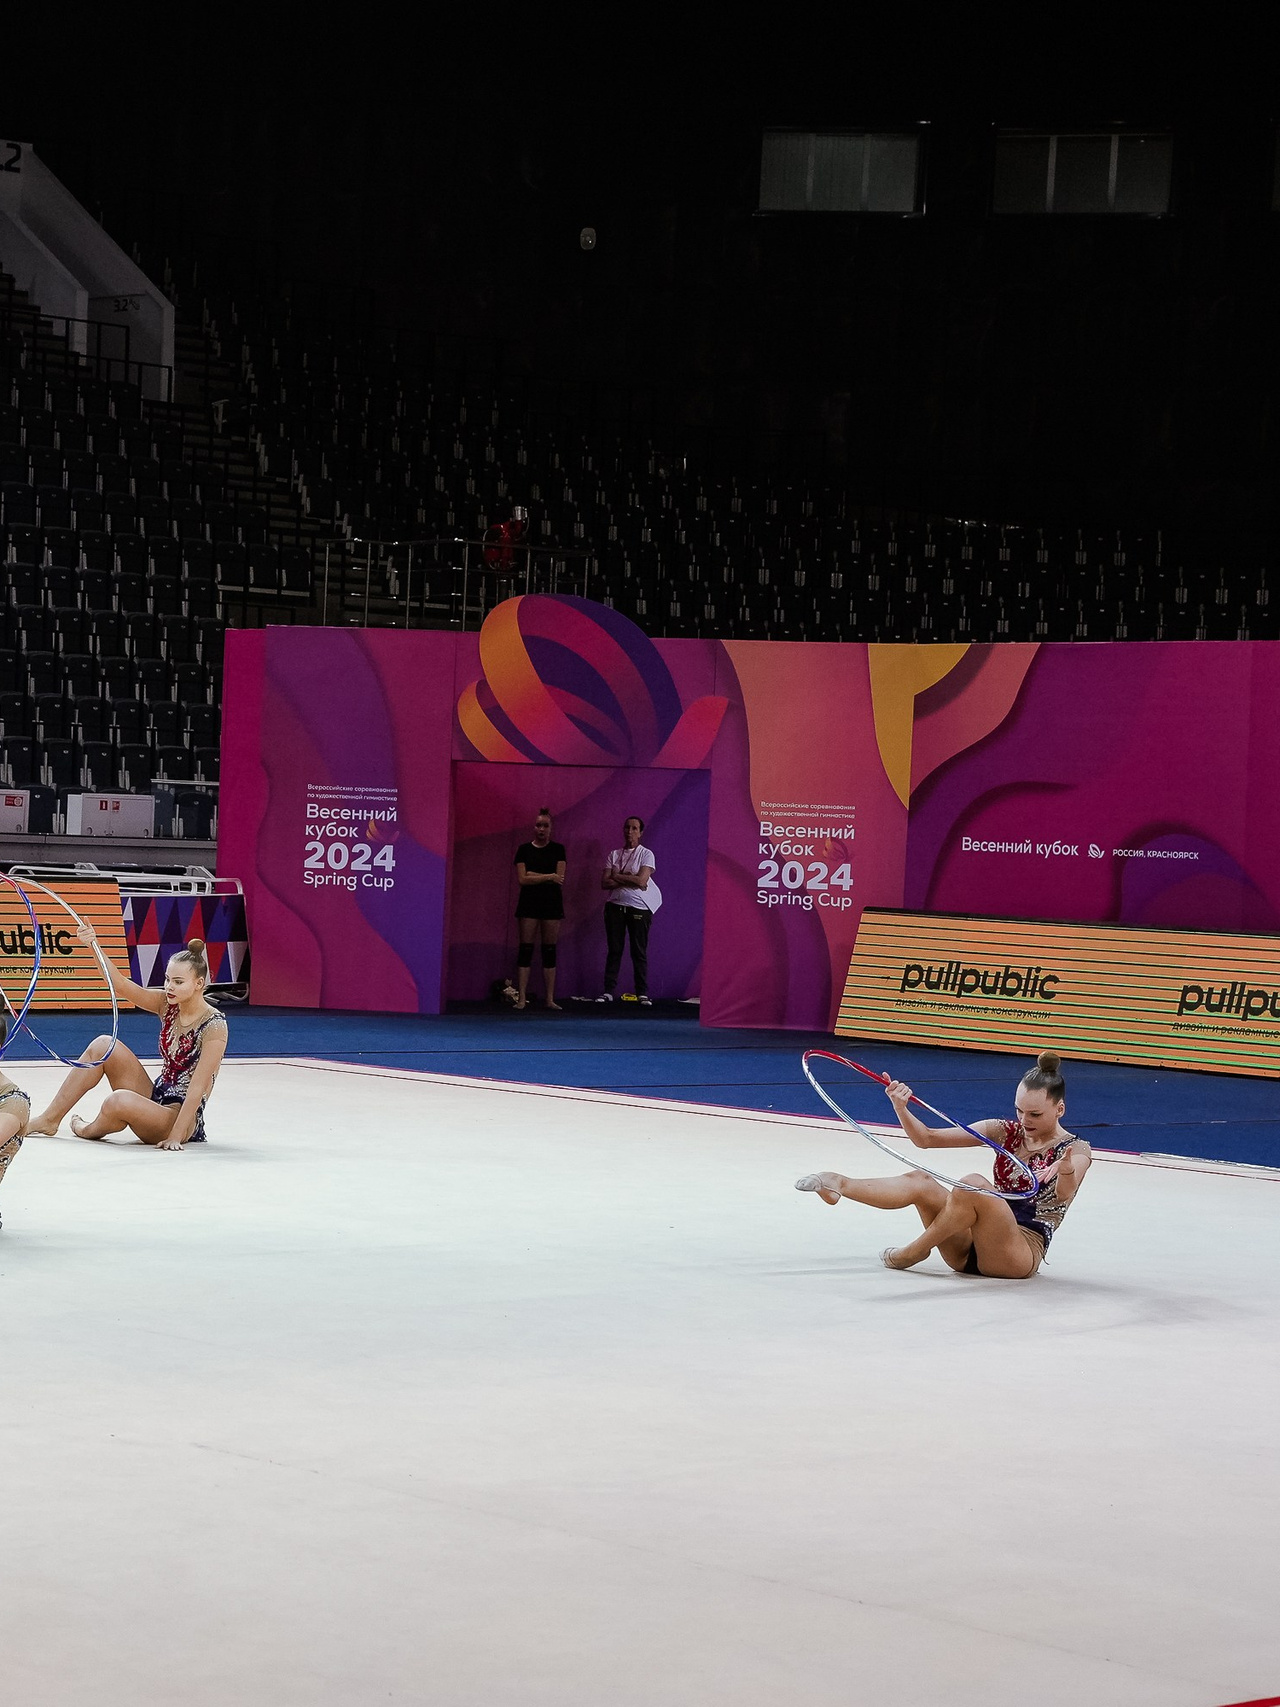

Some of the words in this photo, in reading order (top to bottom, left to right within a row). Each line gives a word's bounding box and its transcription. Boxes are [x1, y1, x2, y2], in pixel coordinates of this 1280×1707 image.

[307, 784, 354, 792] Всероссийские
[306, 803, 397, 822] Весенний
[761, 801, 809, 809] Всероссийские
[305, 822, 358, 840] кубок
[760, 821, 855, 840] Весенний
[304, 841, 396, 872] 2024
[758, 840, 814, 859] кубок
[962, 836, 1032, 854] Весенний
[1036, 840, 1079, 858] кубок
[1112, 849, 1146, 859] РОССИЯ,
[1147, 850, 1199, 860] КРАСНОЯРСК
[303, 871, 358, 891] Spring
[362, 874, 394, 892] Cup
[757, 860, 854, 891] 2024
[756, 890, 813, 910] Spring
[818, 892, 852, 911] Cup
[900, 960, 1060, 1000] pullpublic
